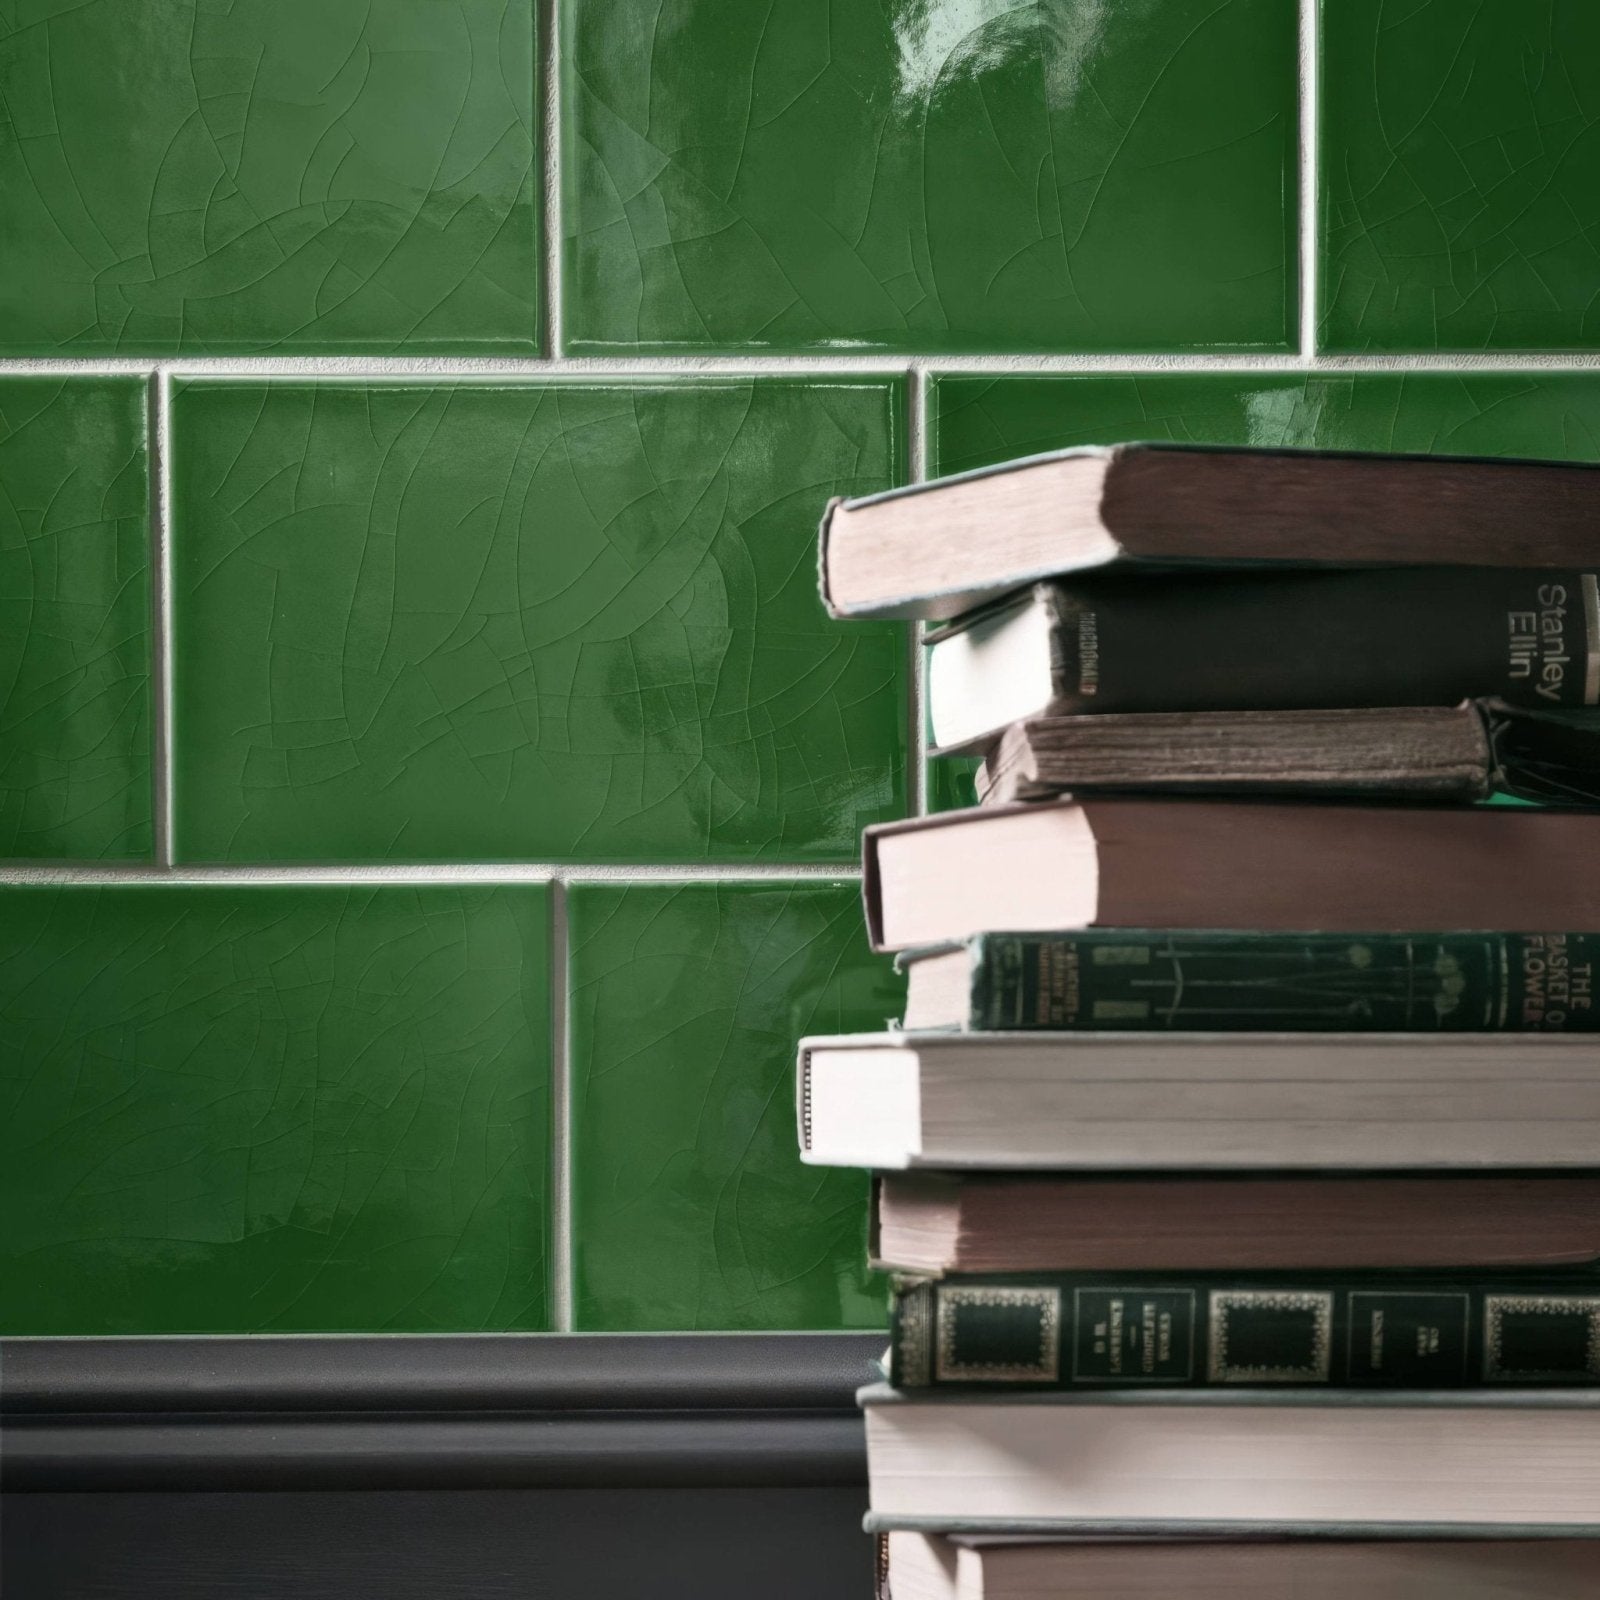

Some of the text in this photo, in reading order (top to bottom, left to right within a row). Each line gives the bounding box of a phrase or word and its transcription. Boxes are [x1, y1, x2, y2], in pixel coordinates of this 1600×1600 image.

[1508, 611, 1538, 678] Ellin
[1535, 584, 1571, 700] Stanley
[1571, 963, 1591, 1010] THE
